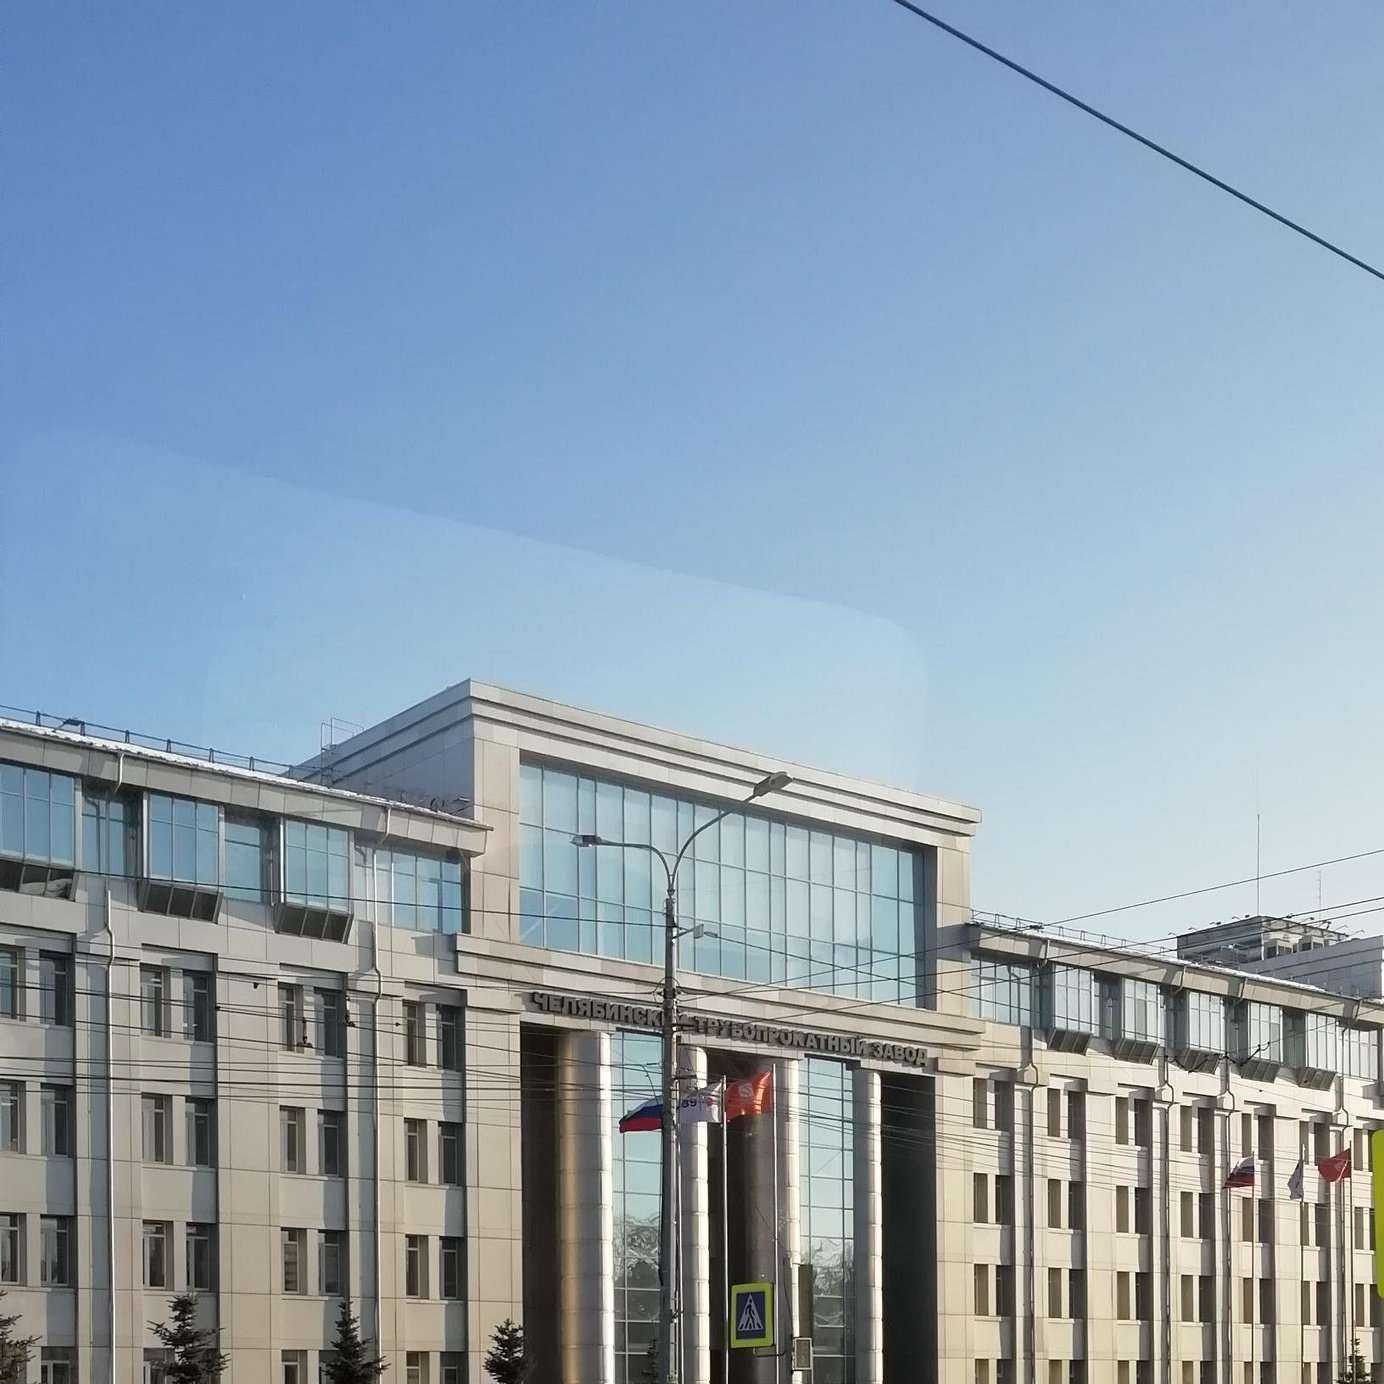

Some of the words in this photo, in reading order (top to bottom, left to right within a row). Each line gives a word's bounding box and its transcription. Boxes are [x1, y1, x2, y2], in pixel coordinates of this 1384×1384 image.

[532, 991, 692, 1034] ЧЕЛЯБИНСК
[695, 1016, 869, 1055] ТРУБОПРОКАТНЫЙ
[871, 1040, 929, 1066] ЗАВОД
